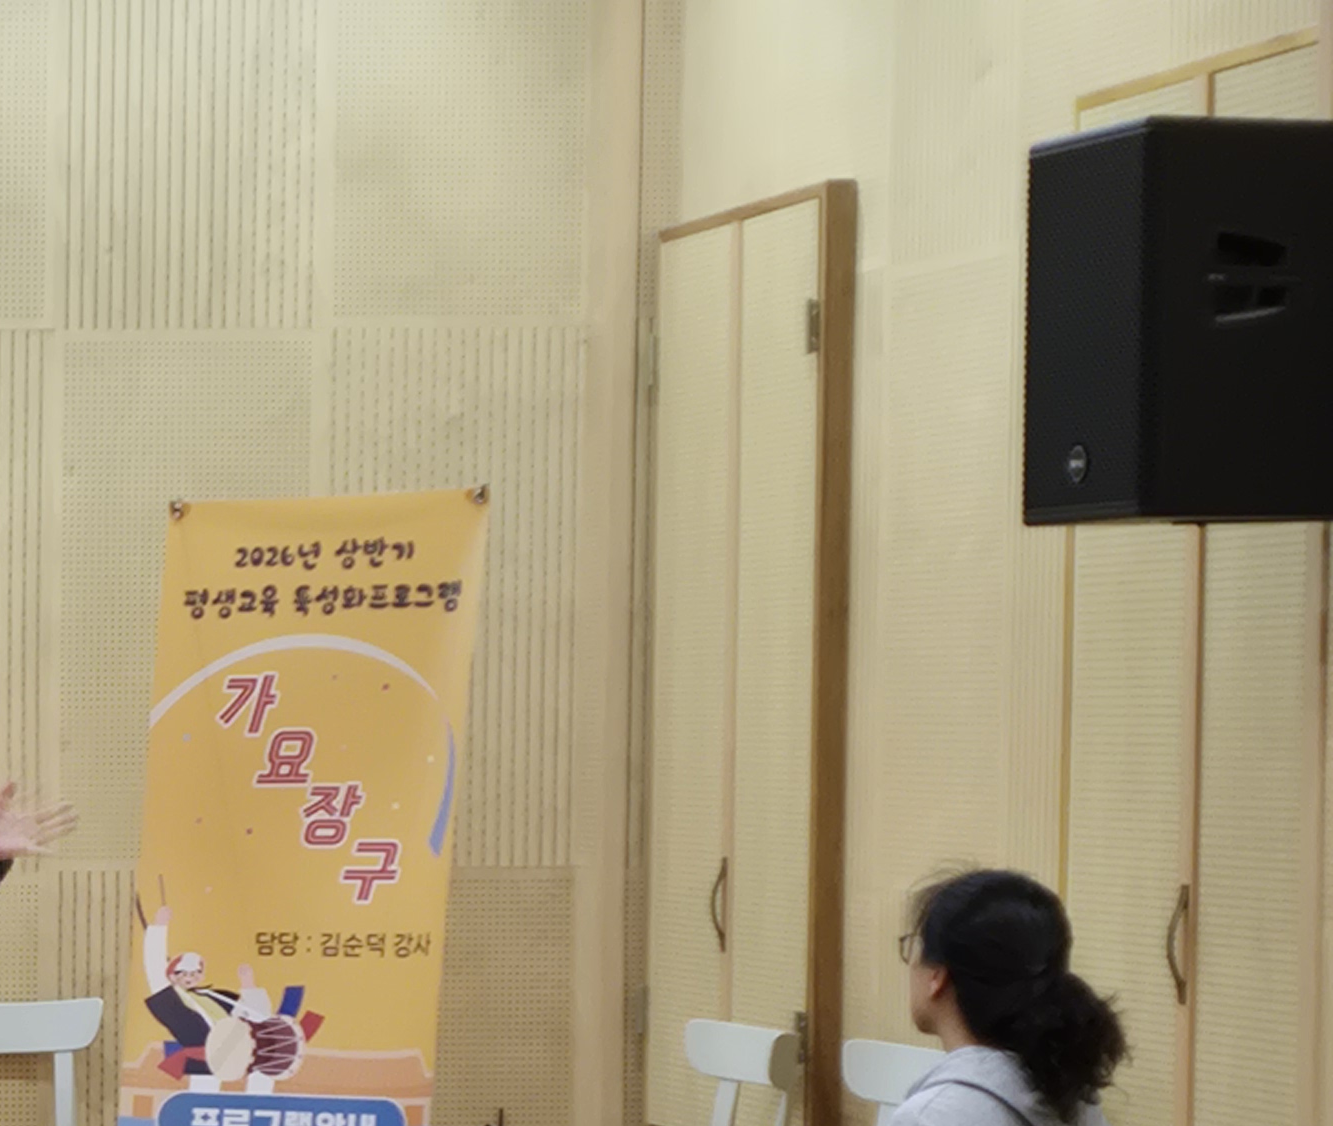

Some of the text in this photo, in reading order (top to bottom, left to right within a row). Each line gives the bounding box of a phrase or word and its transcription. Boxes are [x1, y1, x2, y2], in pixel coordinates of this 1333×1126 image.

[234, 535, 416, 571] 2026년 상반기
[183, 580, 462, 620] 평생교육 특성화프로그램
[255, 931, 299, 957] 담당
[320, 933, 387, 959] 김순덕
[393, 932, 432, 958] 강사
